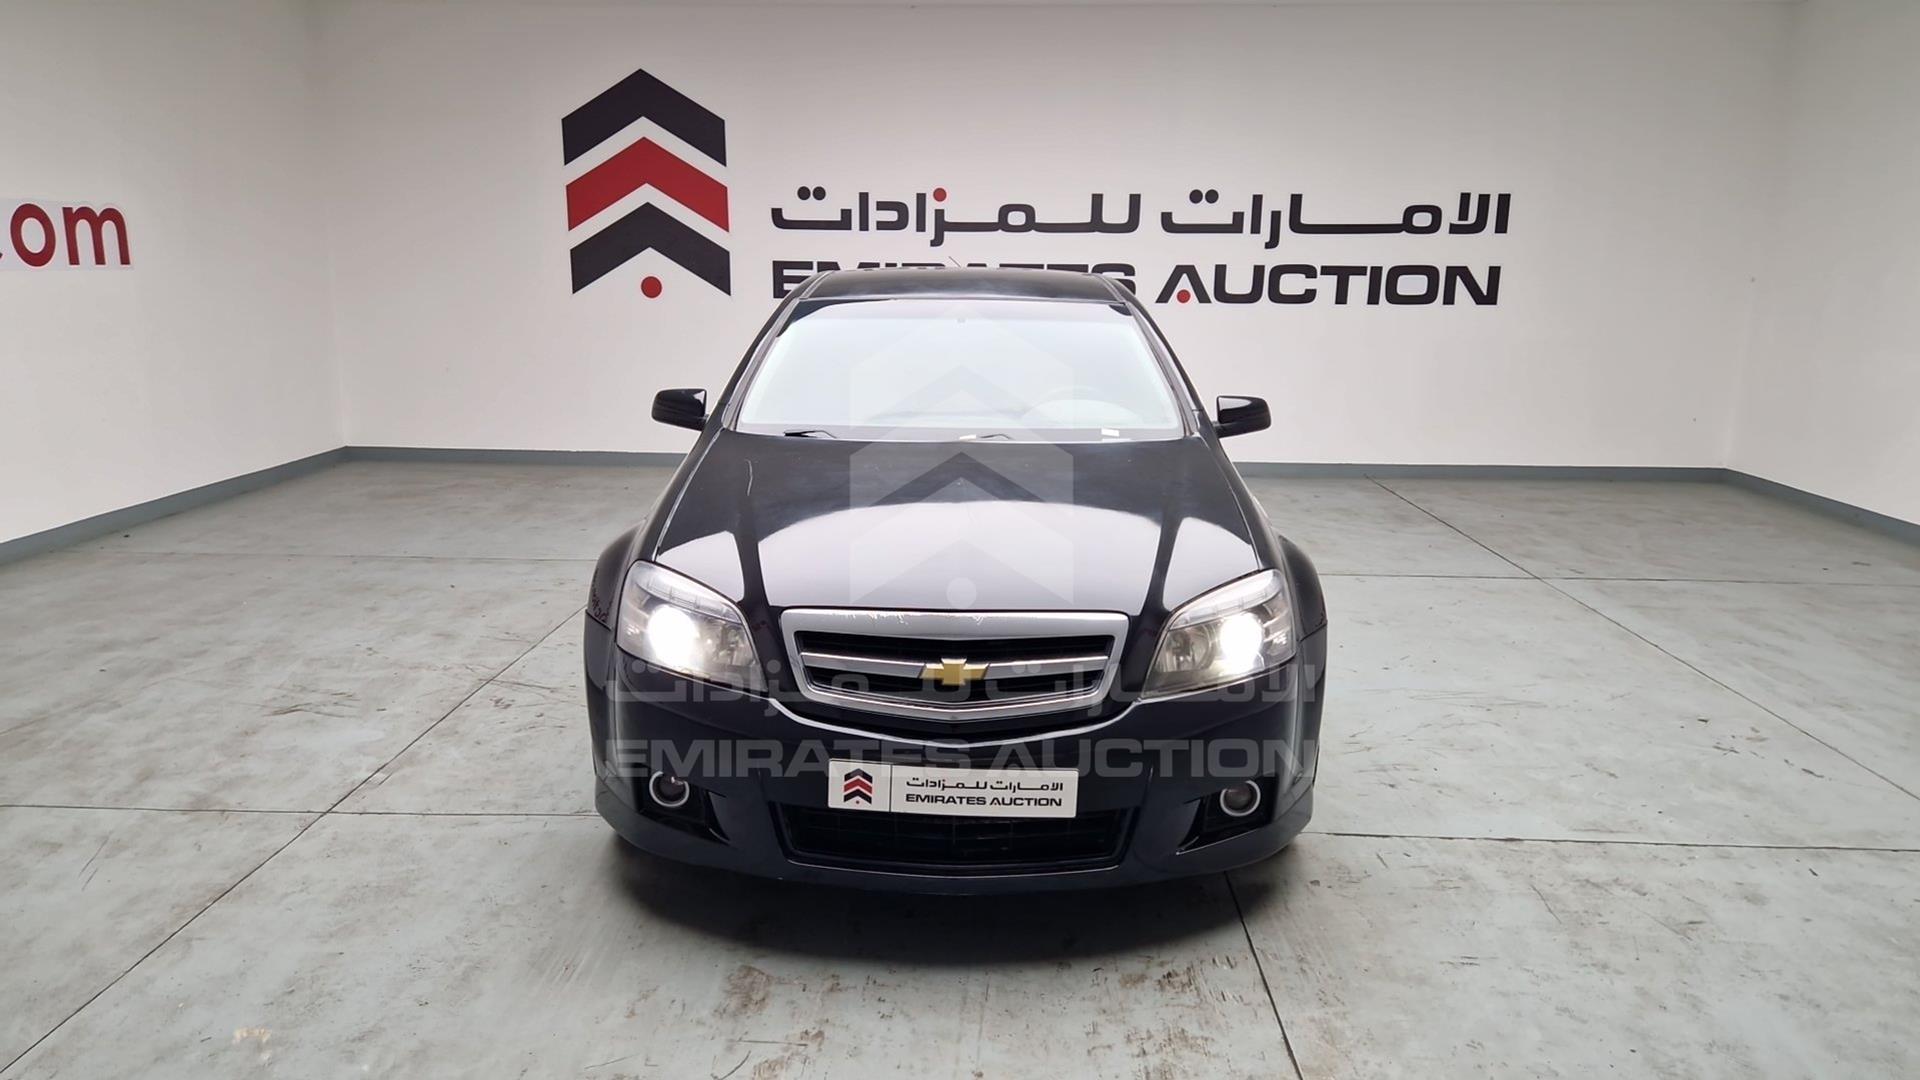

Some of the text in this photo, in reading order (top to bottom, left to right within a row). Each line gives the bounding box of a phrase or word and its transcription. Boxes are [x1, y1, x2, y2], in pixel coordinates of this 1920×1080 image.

[0, 203, 131, 267] om
[770, 186, 1142, 248] للمزادات
[1155, 263, 1502, 306] AUCTION
[905, 793, 1063, 807] EMIRATES AUCTION
